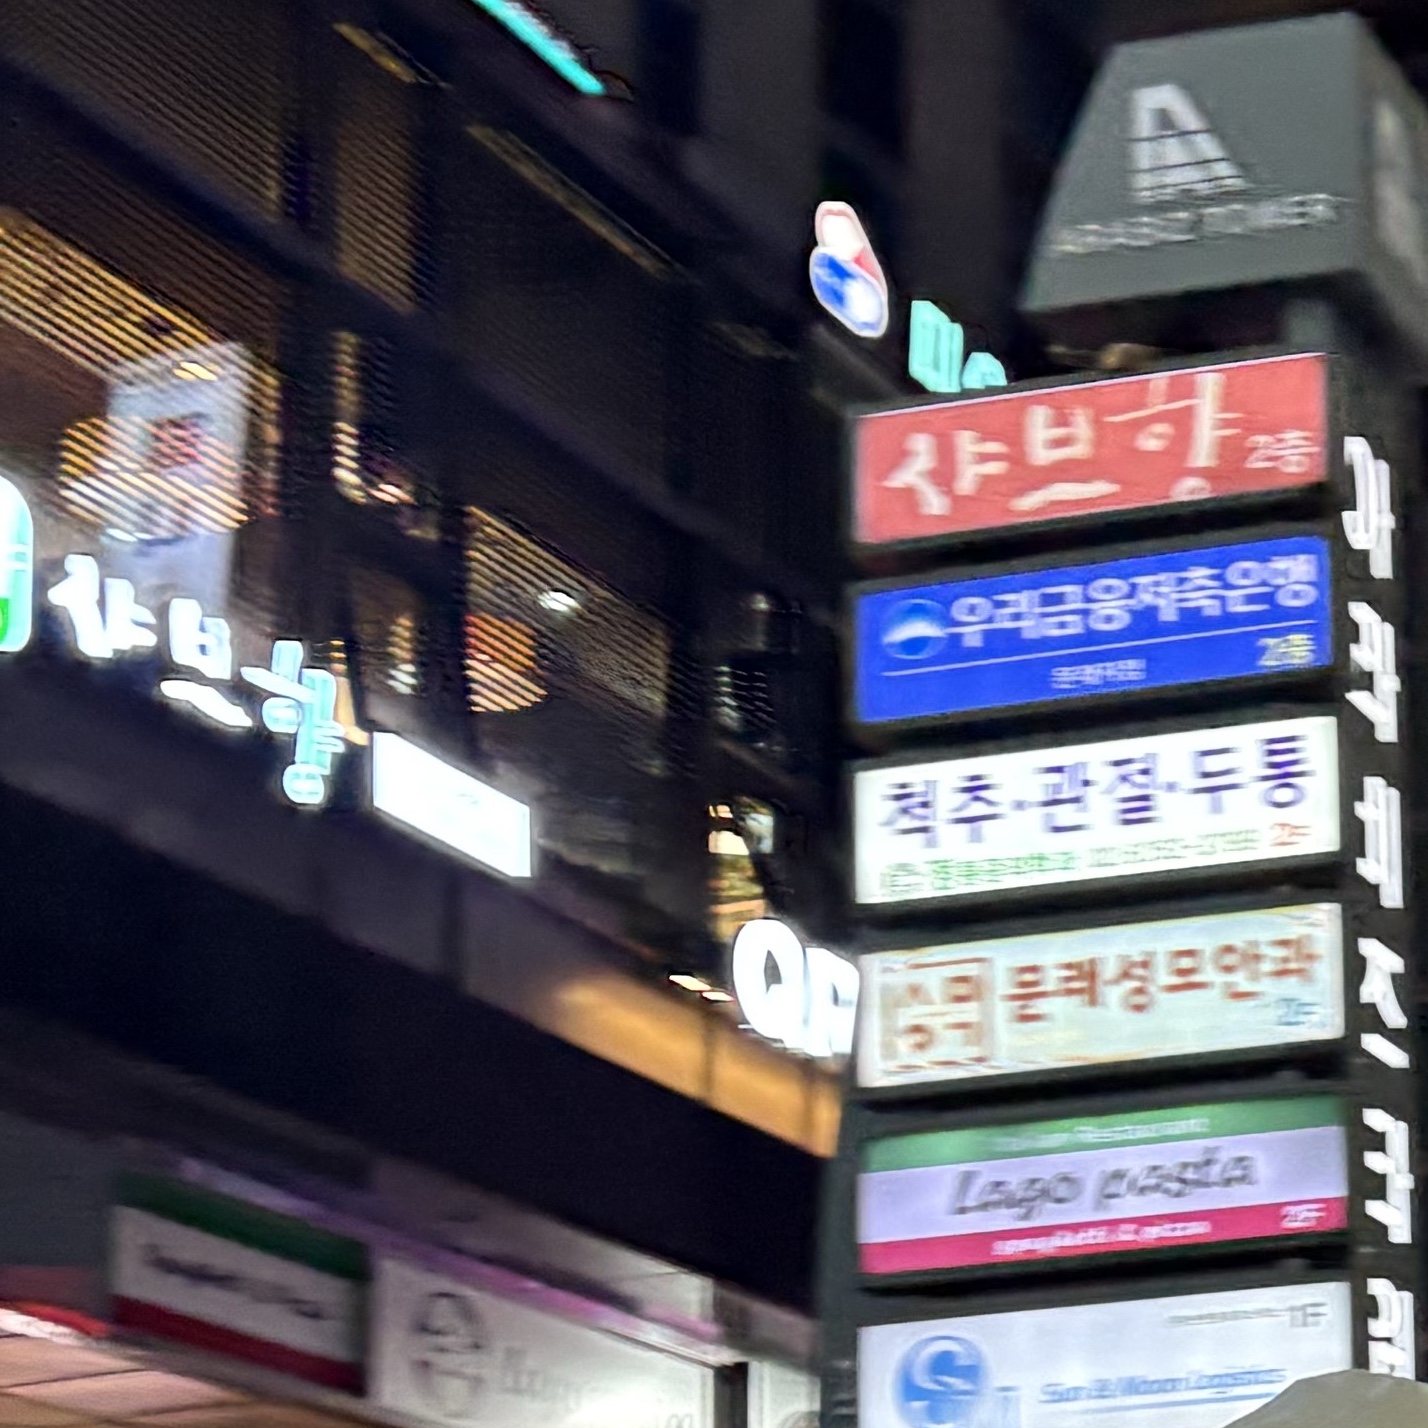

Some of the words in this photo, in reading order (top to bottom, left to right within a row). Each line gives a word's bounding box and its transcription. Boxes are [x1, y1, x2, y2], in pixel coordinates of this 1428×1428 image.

[881, 372, 1242, 515] 샤브향
[944, 554, 1319, 648] 우리금융저축은행
[47, 553, 346, 805] 샤브향
[999, 933, 1322, 1024] 문래성모안과
[1094, 1146, 1260, 1213] pasta
